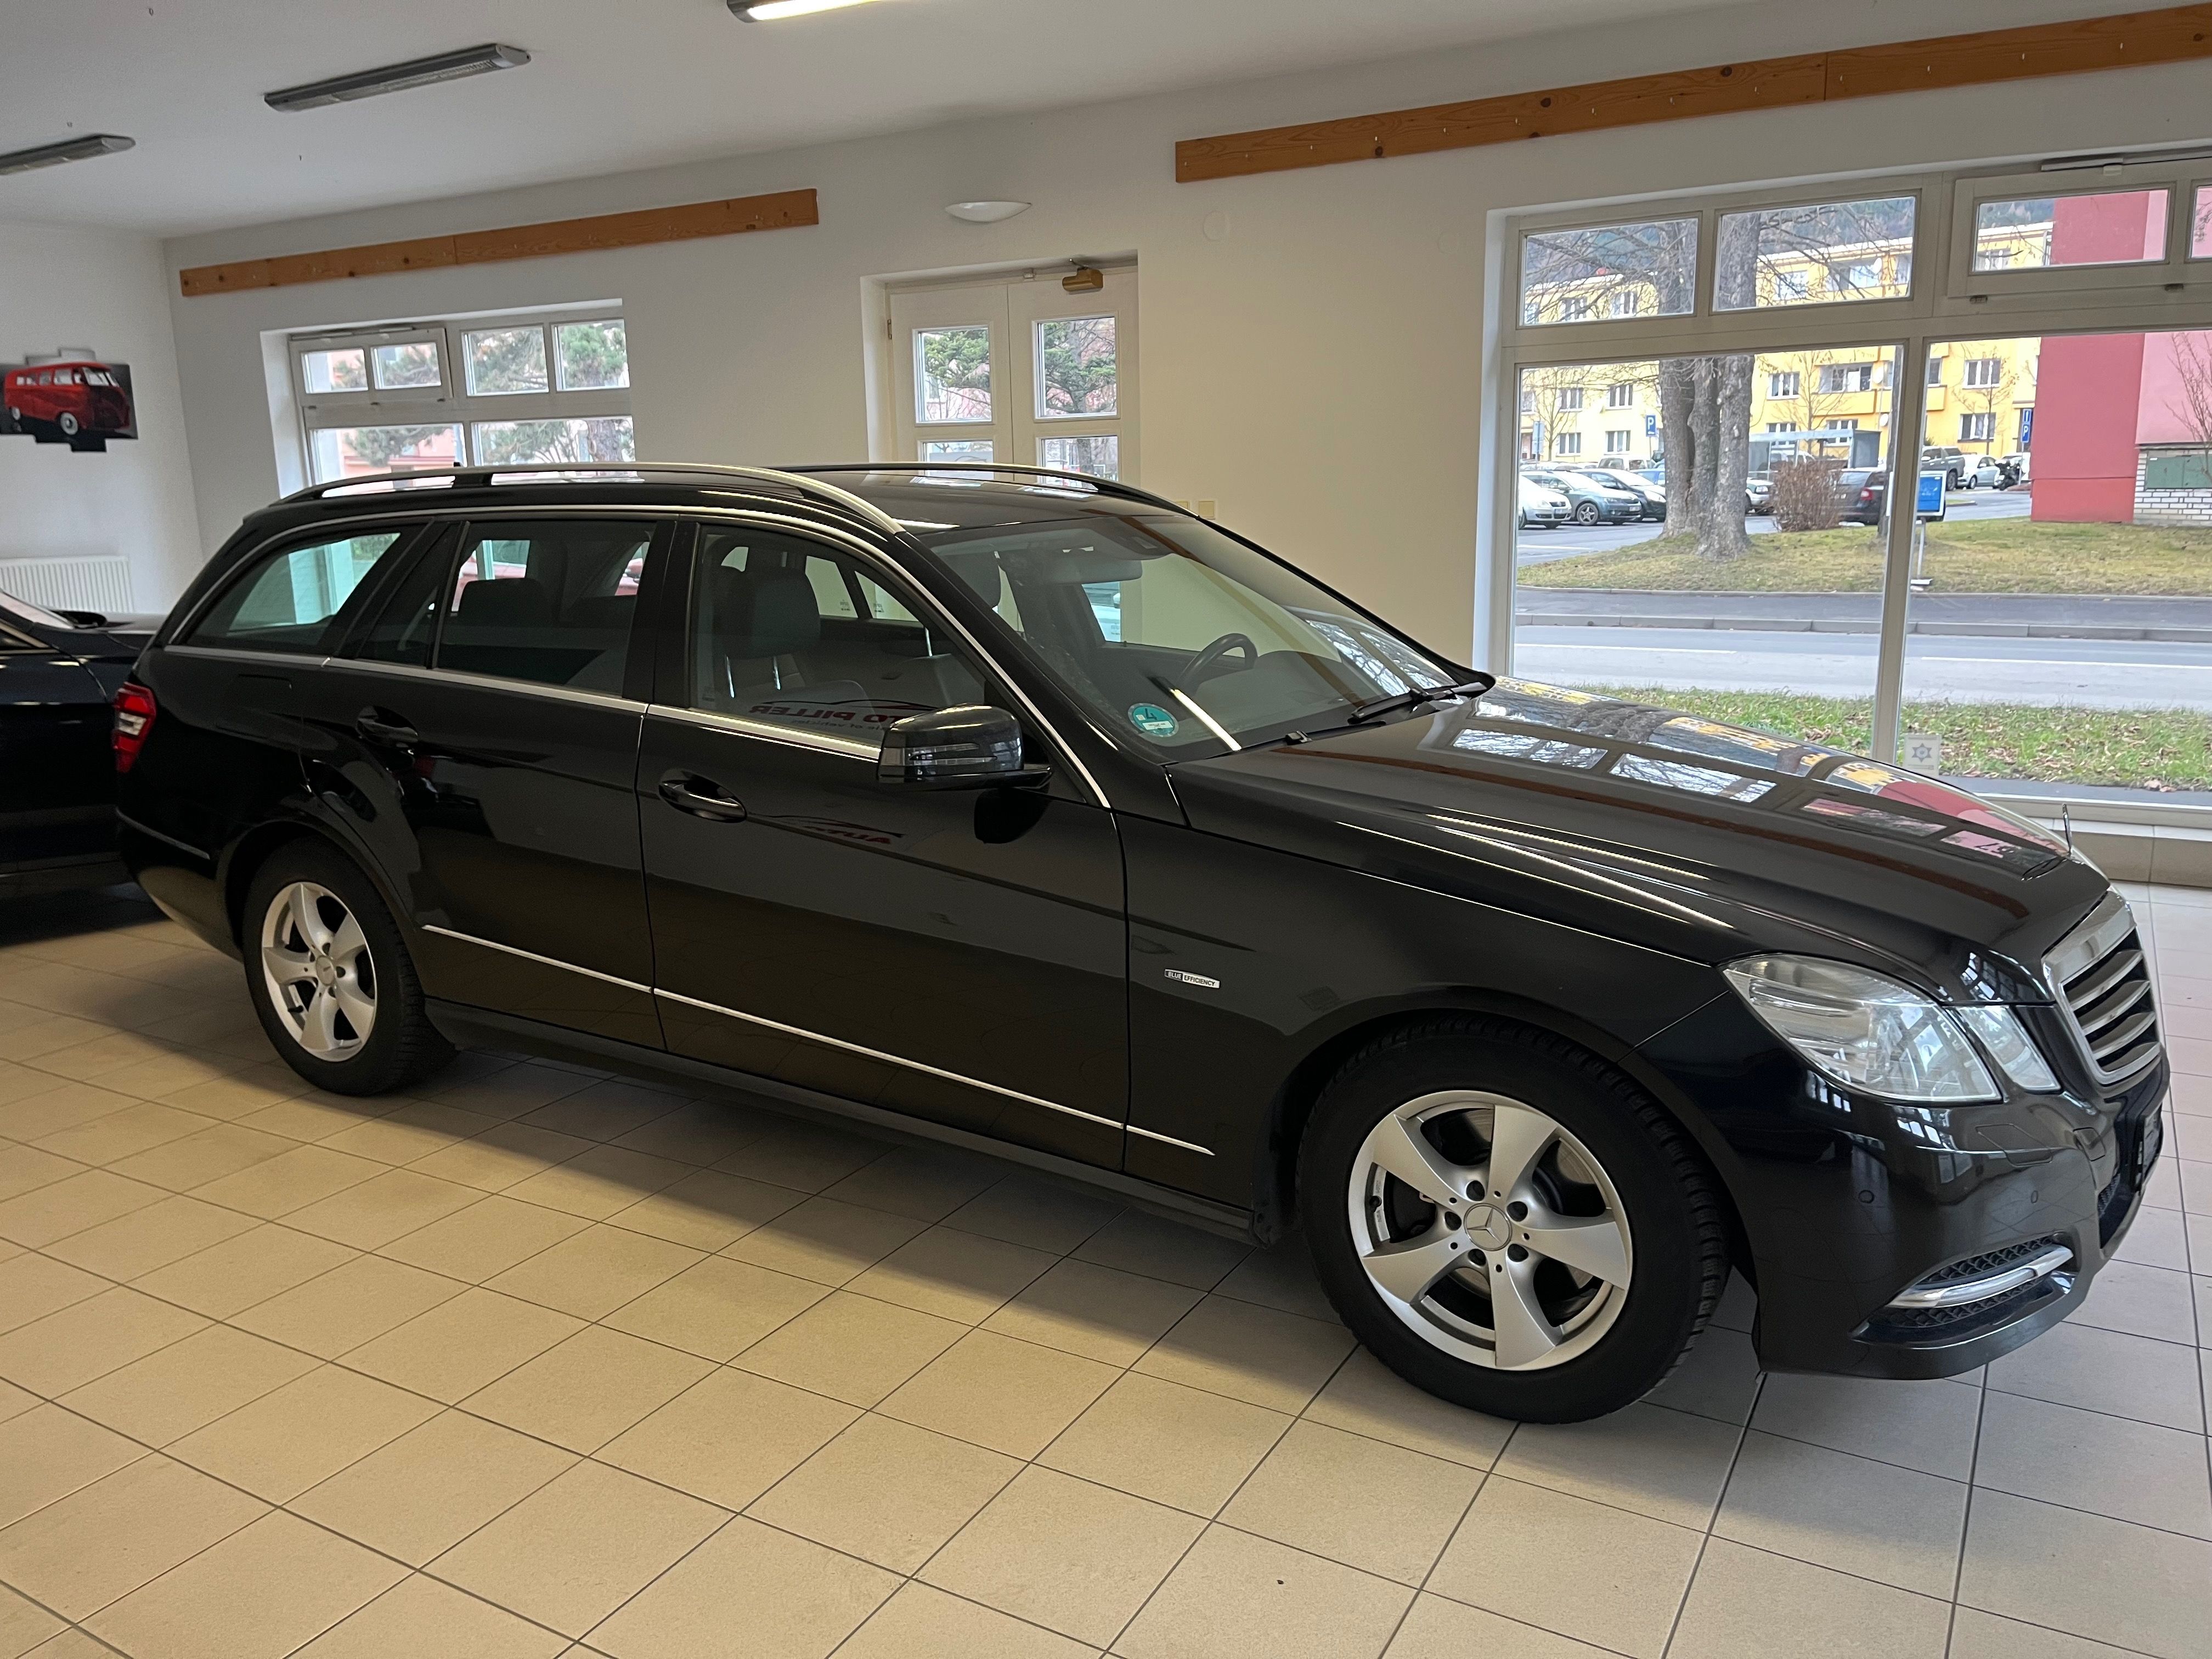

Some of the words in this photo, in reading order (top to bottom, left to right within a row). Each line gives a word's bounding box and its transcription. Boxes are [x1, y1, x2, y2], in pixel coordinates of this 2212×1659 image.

[1647, 417, 1654, 430] P
[2023, 425, 2029, 437] P
[1144, 708, 1158, 720] 4
[1168, 971, 1182, 979] BLUE
[1184, 975, 1216, 986] EFFICIENCY
